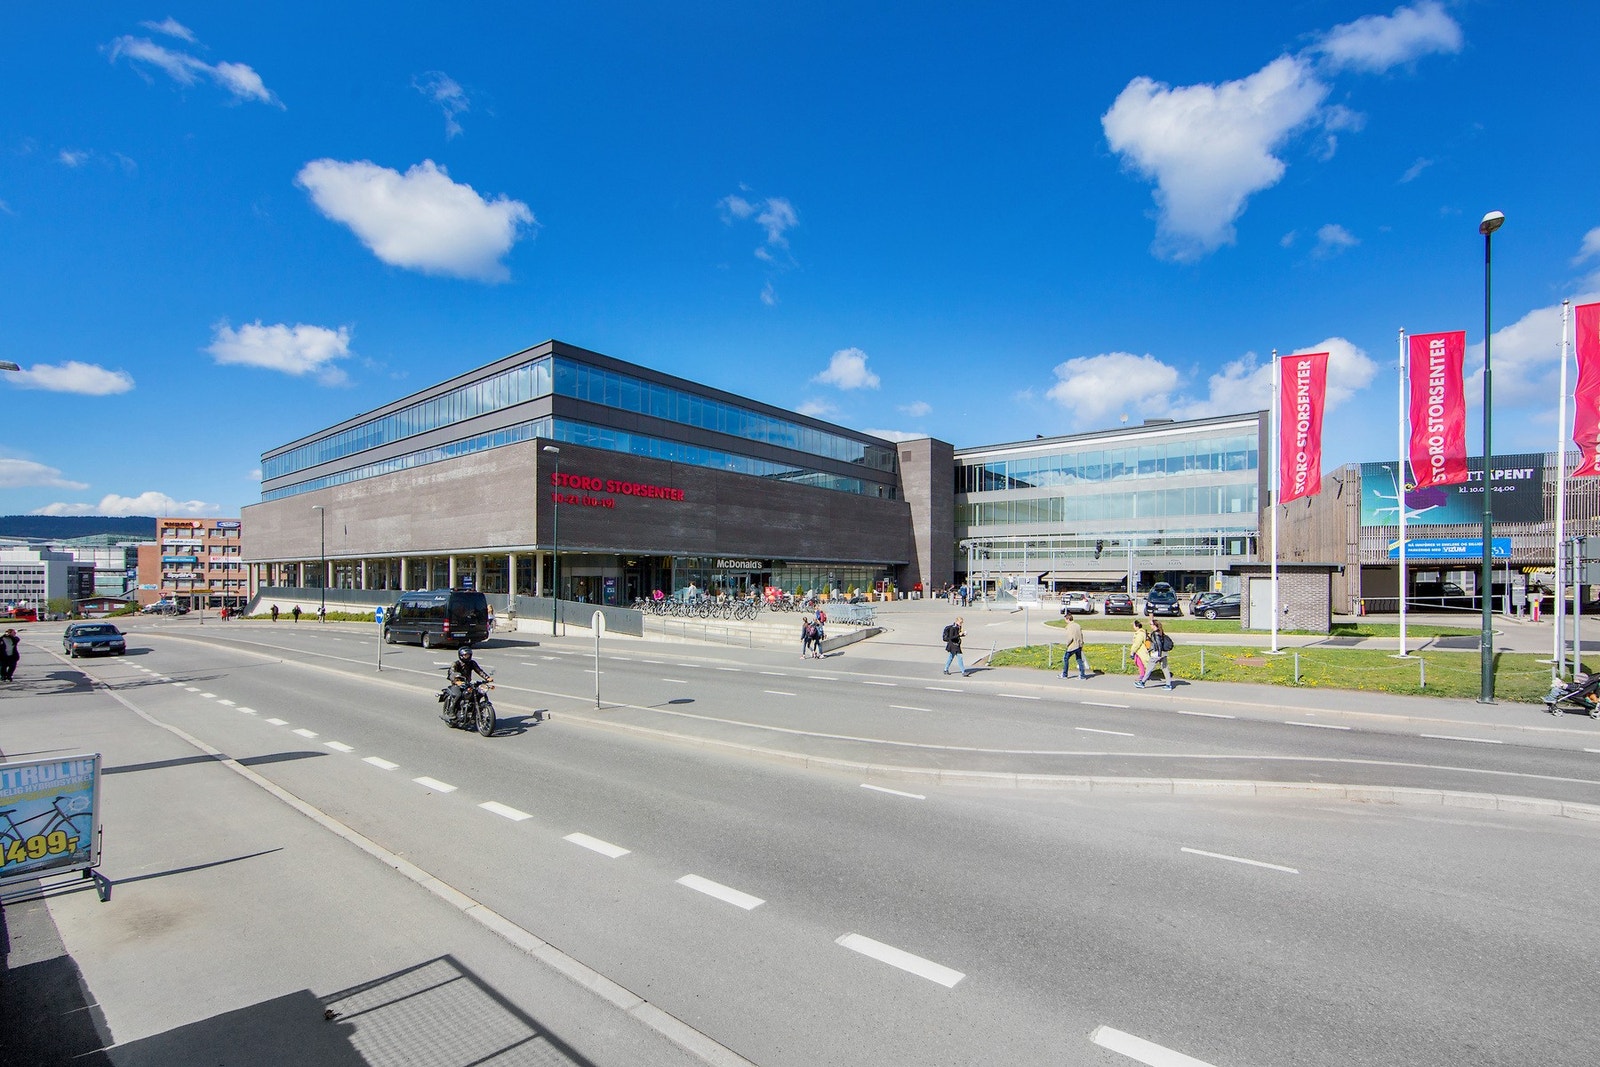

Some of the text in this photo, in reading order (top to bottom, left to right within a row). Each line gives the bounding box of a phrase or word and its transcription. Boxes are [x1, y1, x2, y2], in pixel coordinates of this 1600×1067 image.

[1428, 338, 1447, 483] STORO STORSENTER
[1295, 360, 1311, 495] STORO STORSENTER
[551, 472, 685, 501] STORO STORSENTER
[1467, 469, 1533, 481] TTPENT
[716, 559, 763, 570] McDonald's
